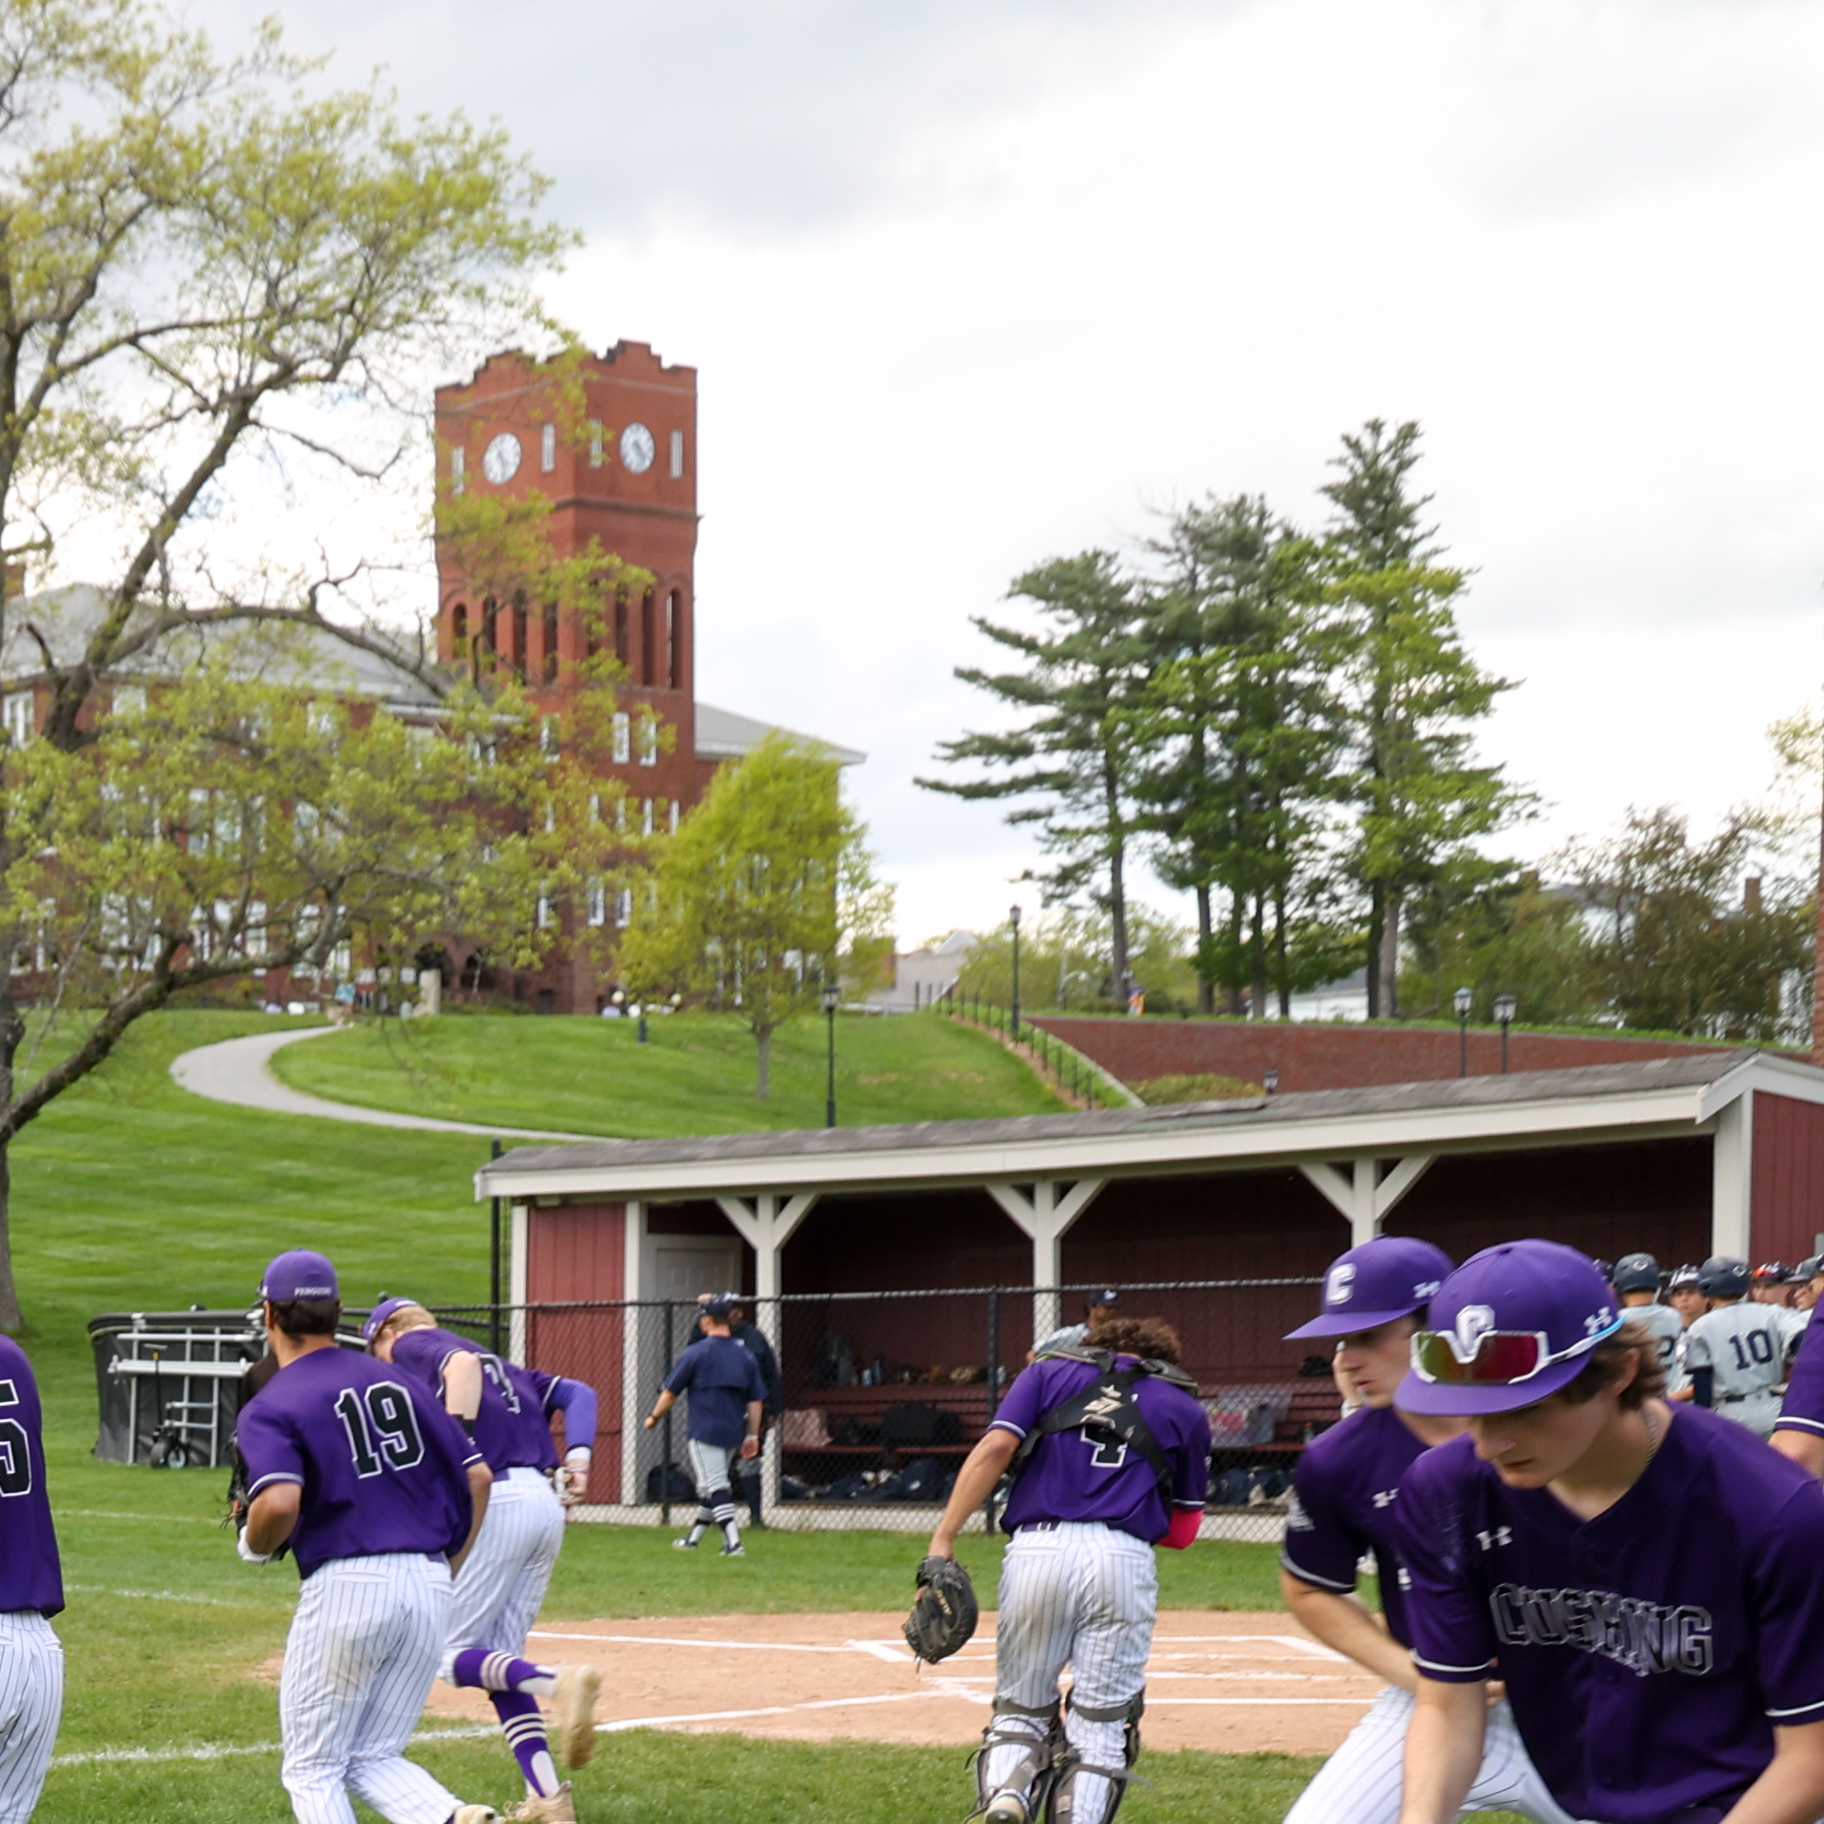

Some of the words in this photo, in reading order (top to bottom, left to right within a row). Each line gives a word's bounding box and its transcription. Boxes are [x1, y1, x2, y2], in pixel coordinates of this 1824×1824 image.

[1325, 1262, 1357, 1306] C
[1728, 1329, 1774, 1371] 10
[334, 1381, 425, 1479] 19
